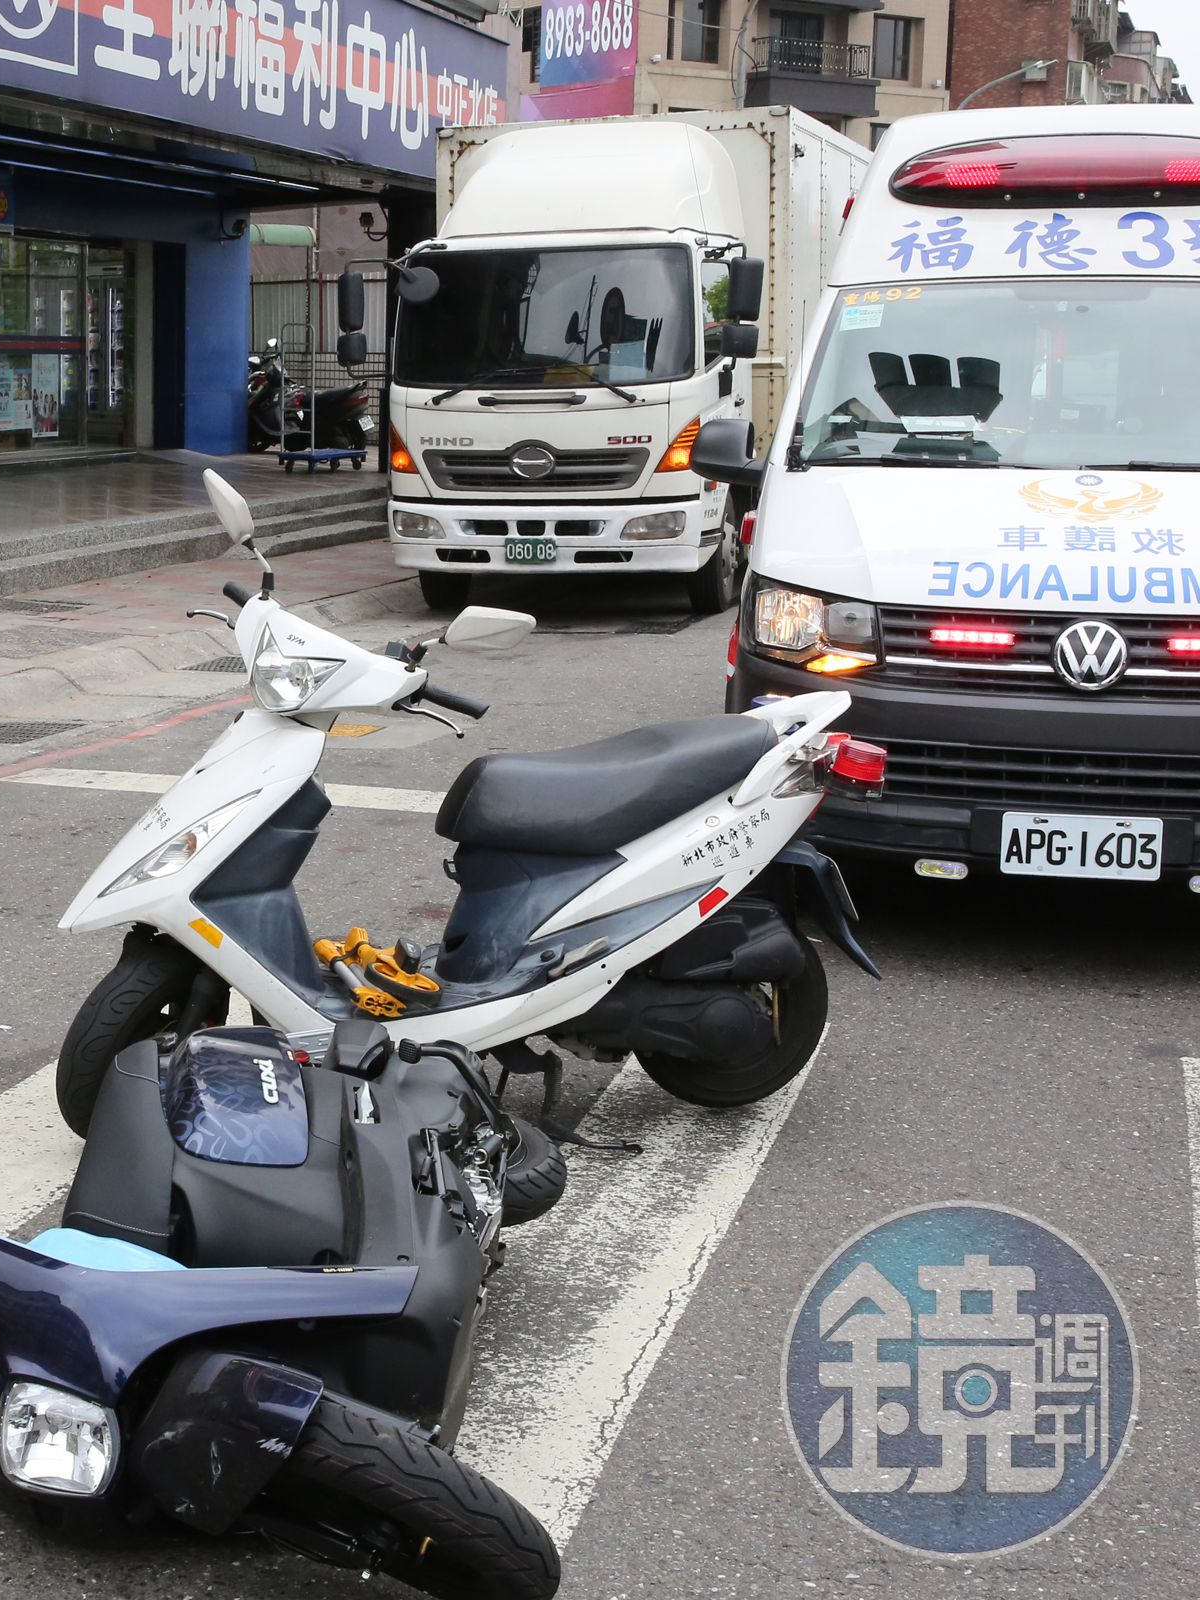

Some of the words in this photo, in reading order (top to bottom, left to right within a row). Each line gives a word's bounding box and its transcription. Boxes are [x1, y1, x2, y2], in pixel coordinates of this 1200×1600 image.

[544, 0, 634, 61] 8983-8688
[886, 210, 1200, 274] 福德3
[420, 436, 475, 447] HINO
[606, 434, 653, 445] 500
[285, 633, 307, 647] SYM
[680, 808, 771, 868] 新北市政府警察局
[1005, 826, 1158, 871] APG-1603
